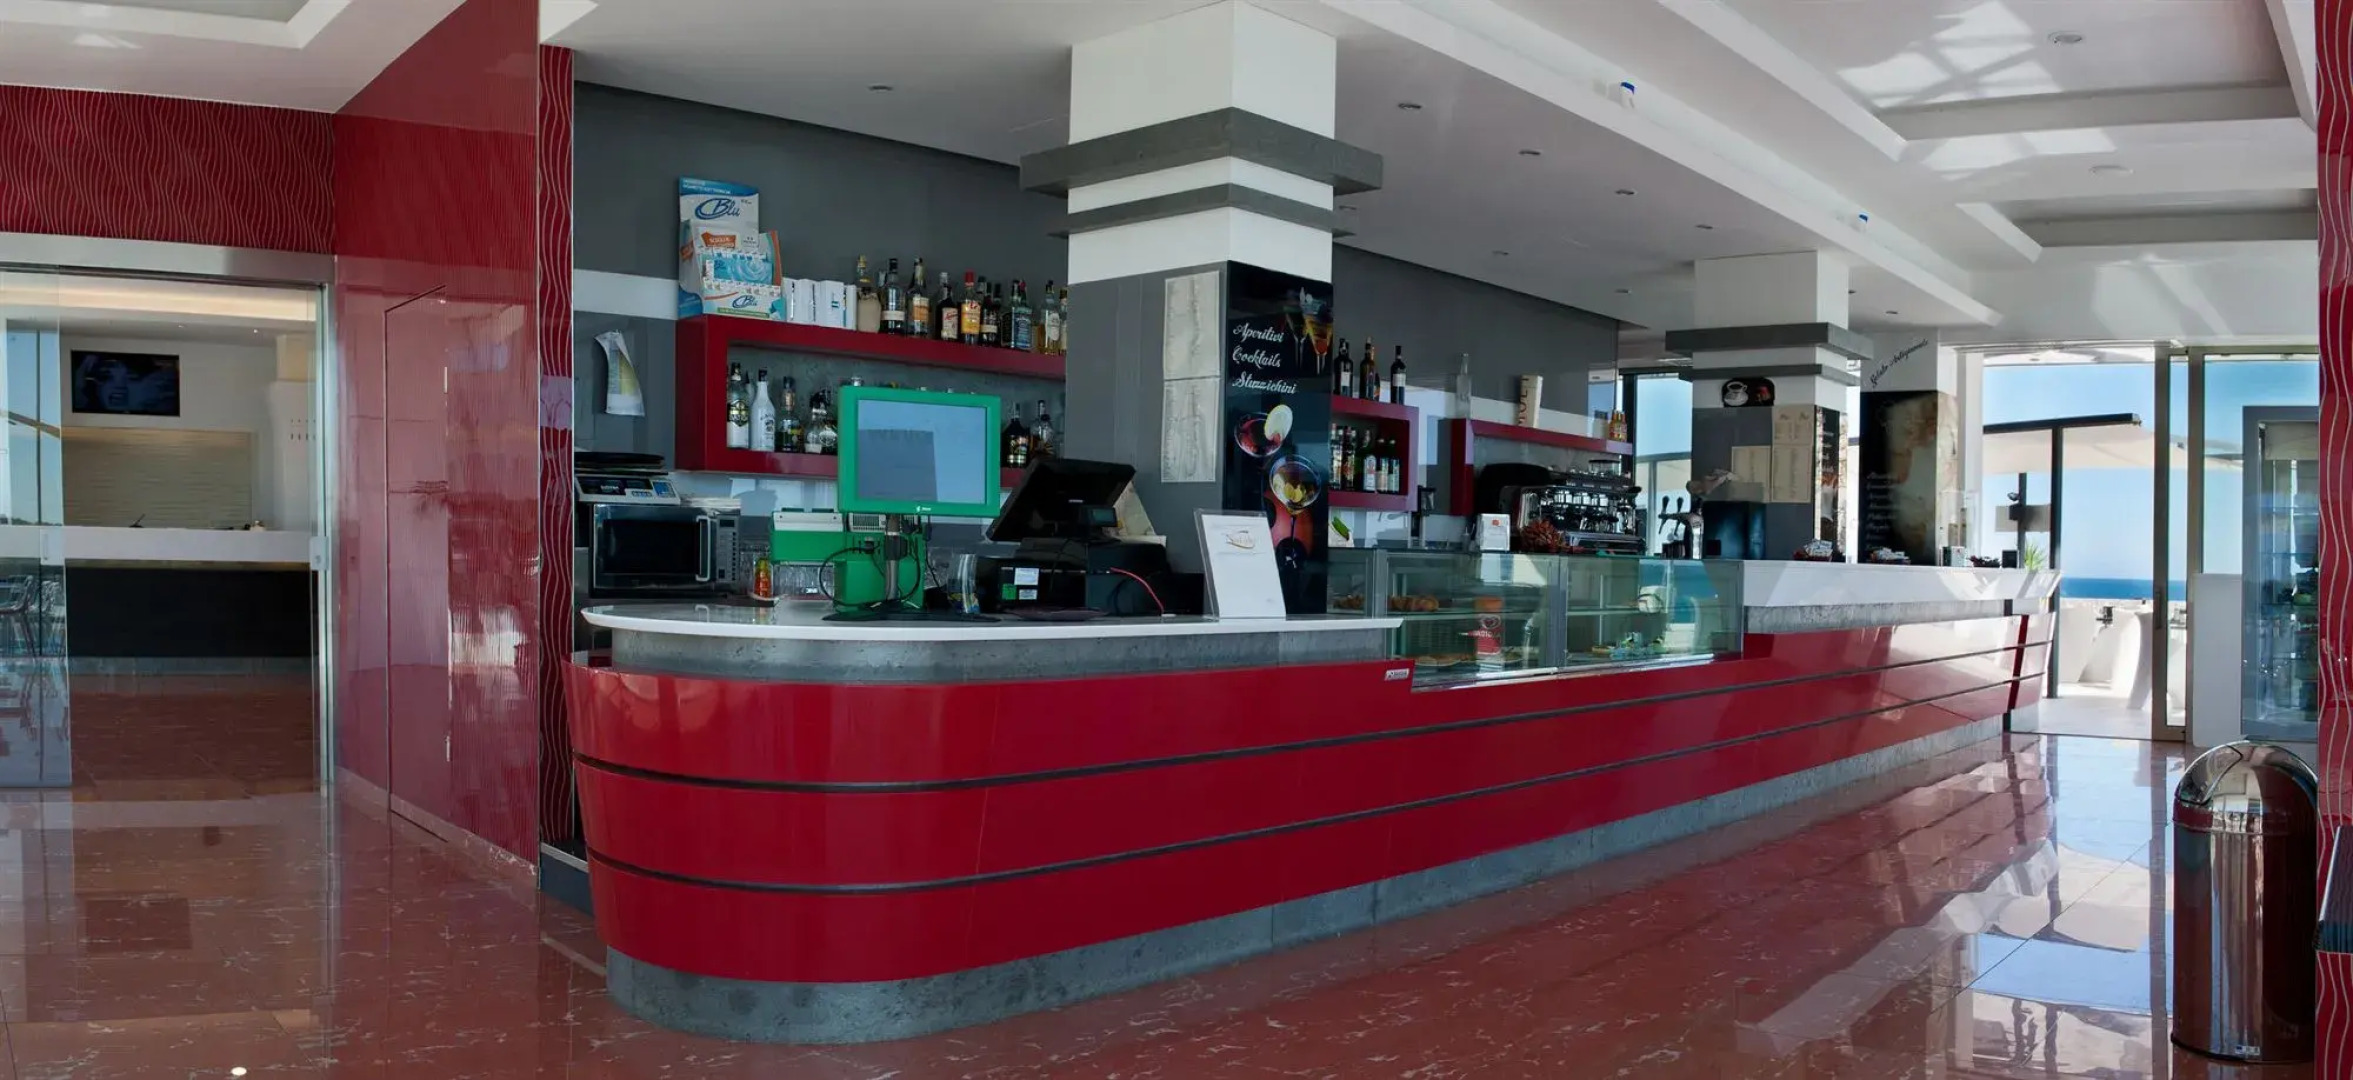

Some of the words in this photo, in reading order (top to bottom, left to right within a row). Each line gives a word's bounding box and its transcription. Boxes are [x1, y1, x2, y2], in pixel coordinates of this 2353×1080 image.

[1232, 322, 1285, 342] Aperitivi
[1232, 345, 1281, 369] Cocktails
[1232, 371, 1297, 394] Stuzzichini
